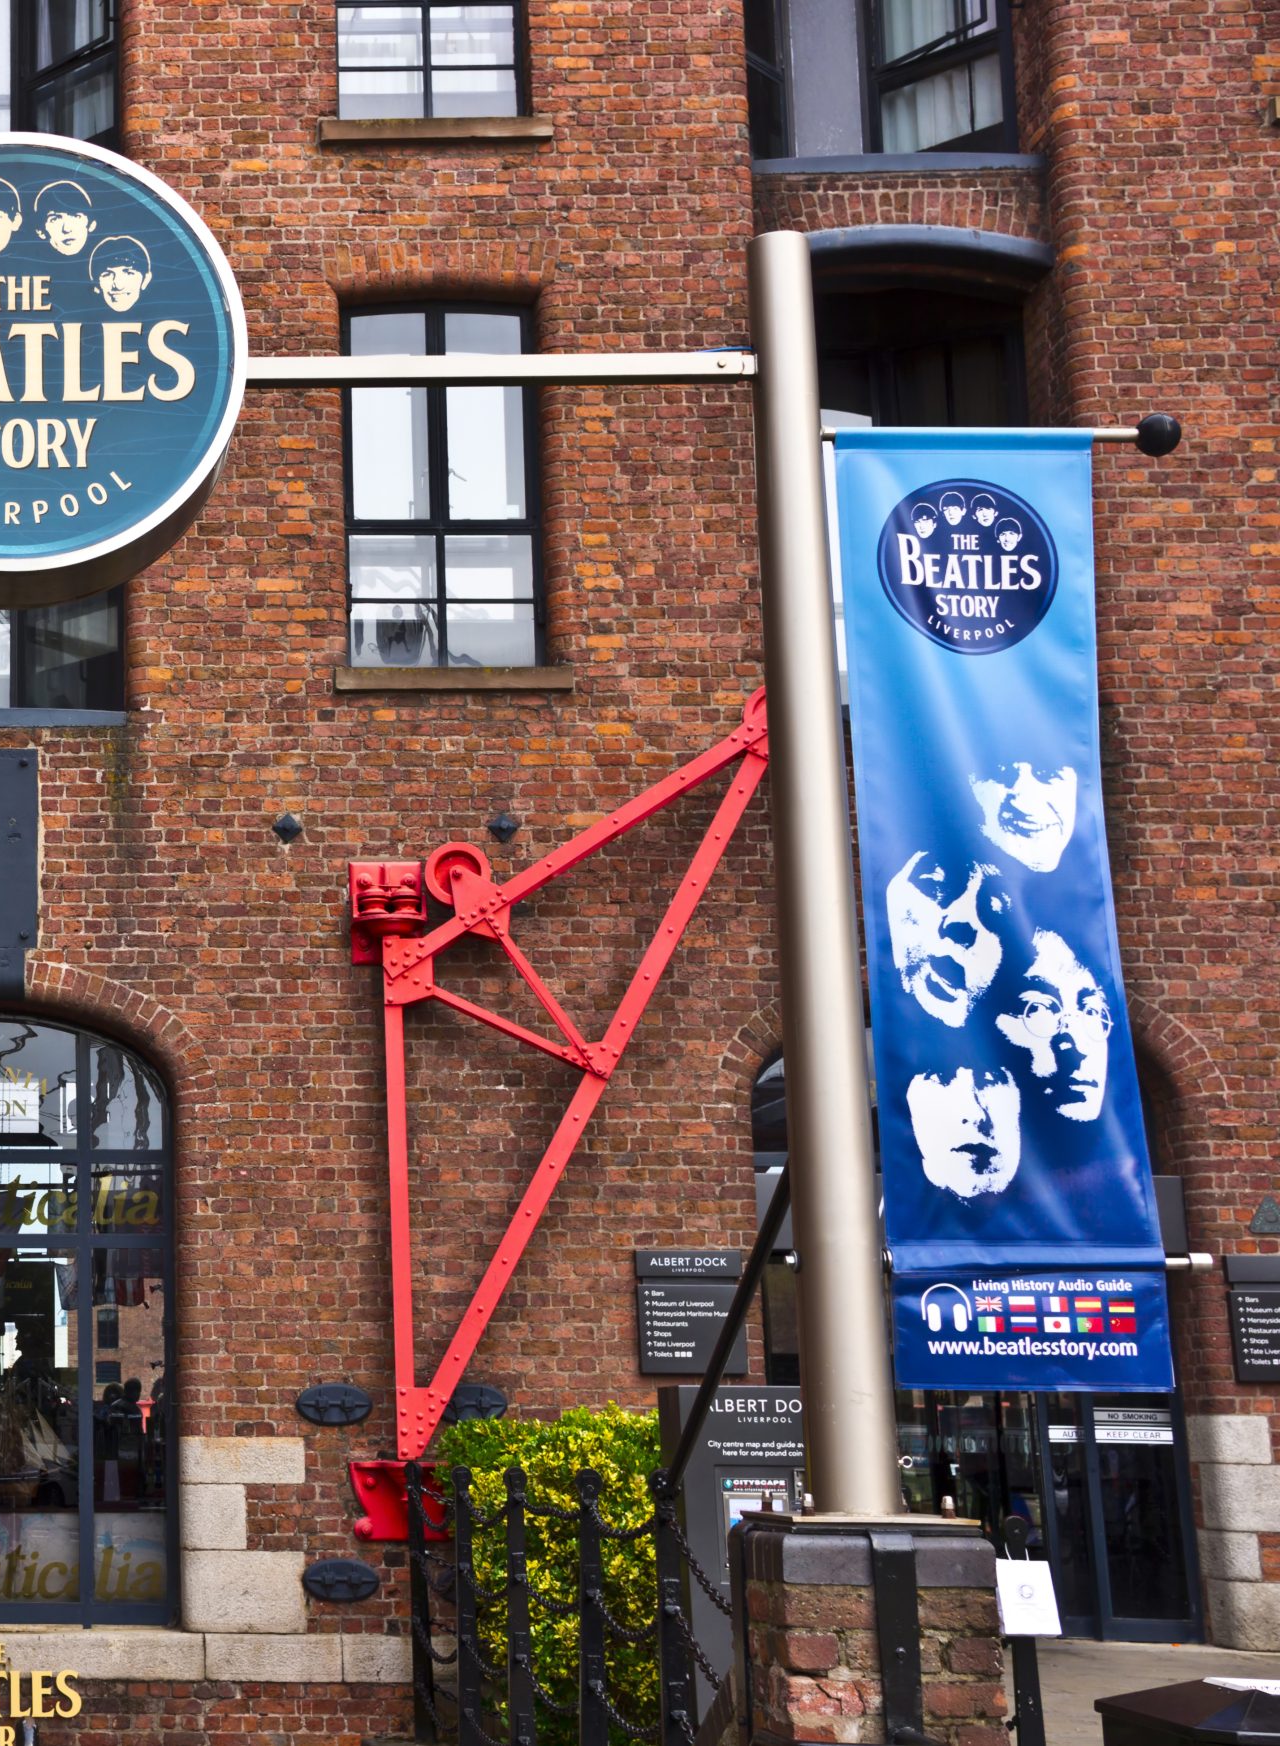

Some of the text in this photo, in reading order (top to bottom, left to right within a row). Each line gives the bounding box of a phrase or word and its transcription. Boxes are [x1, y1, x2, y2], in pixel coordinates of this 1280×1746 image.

[951, 534, 980, 550] THE
[897, 533, 1042, 591] BEATLES
[935, 594, 1000, 618] STORY
[928, 615, 1015, 641] LIVERPOOL
[650, 1258, 727, 1266] ALBERT DOCK
[972, 1279, 1132, 1293] Living History Audio Guide
[928, 1337, 1138, 1360] www.beatlesstory.com
[775, 1399, 802, 1413] DO
[1133, 1431, 1161, 1439] CLEAR
[708, 1440, 721, 1448] City
[776, 1441, 796, 1449] guide
